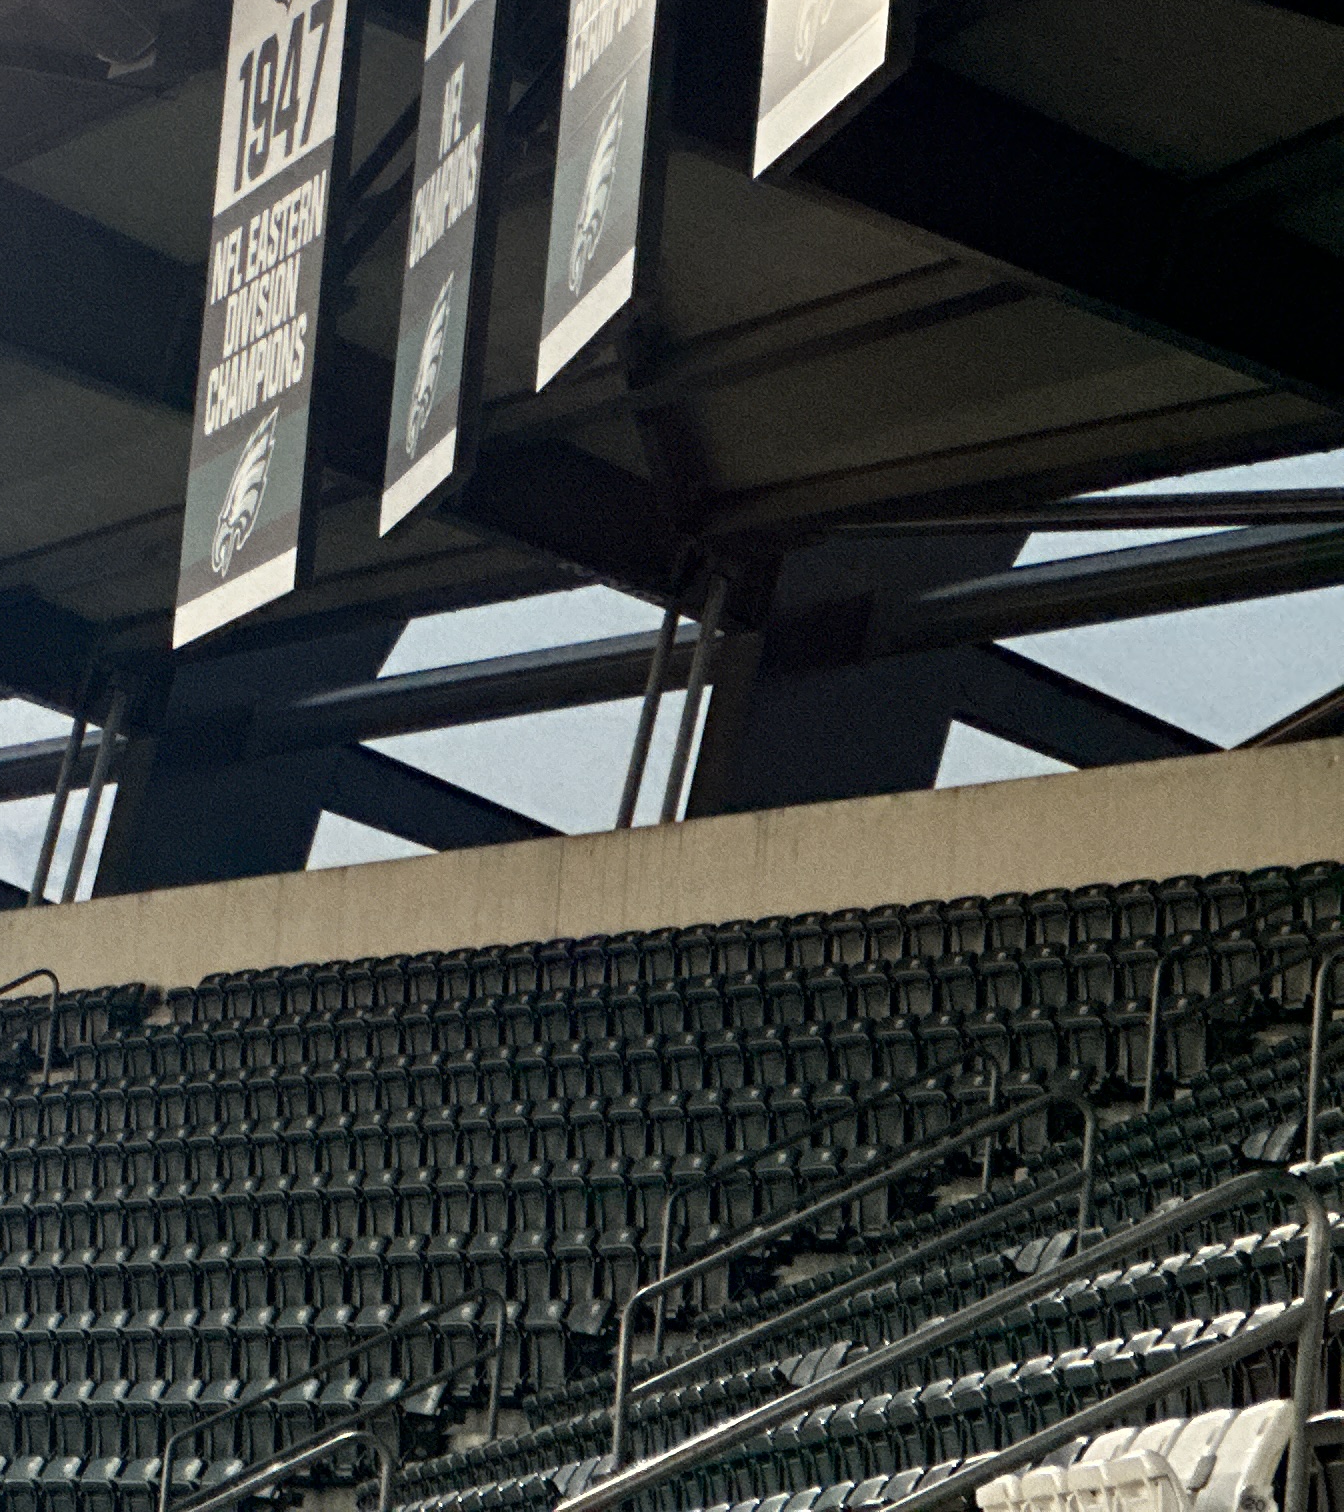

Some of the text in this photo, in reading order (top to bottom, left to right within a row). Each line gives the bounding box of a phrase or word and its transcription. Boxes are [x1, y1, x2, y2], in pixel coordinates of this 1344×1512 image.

[211, 169, 327, 306] NFL EASTERN
[223, 252, 301, 359] DIVISION
[204, 312, 307, 437] CHAMPIONS
